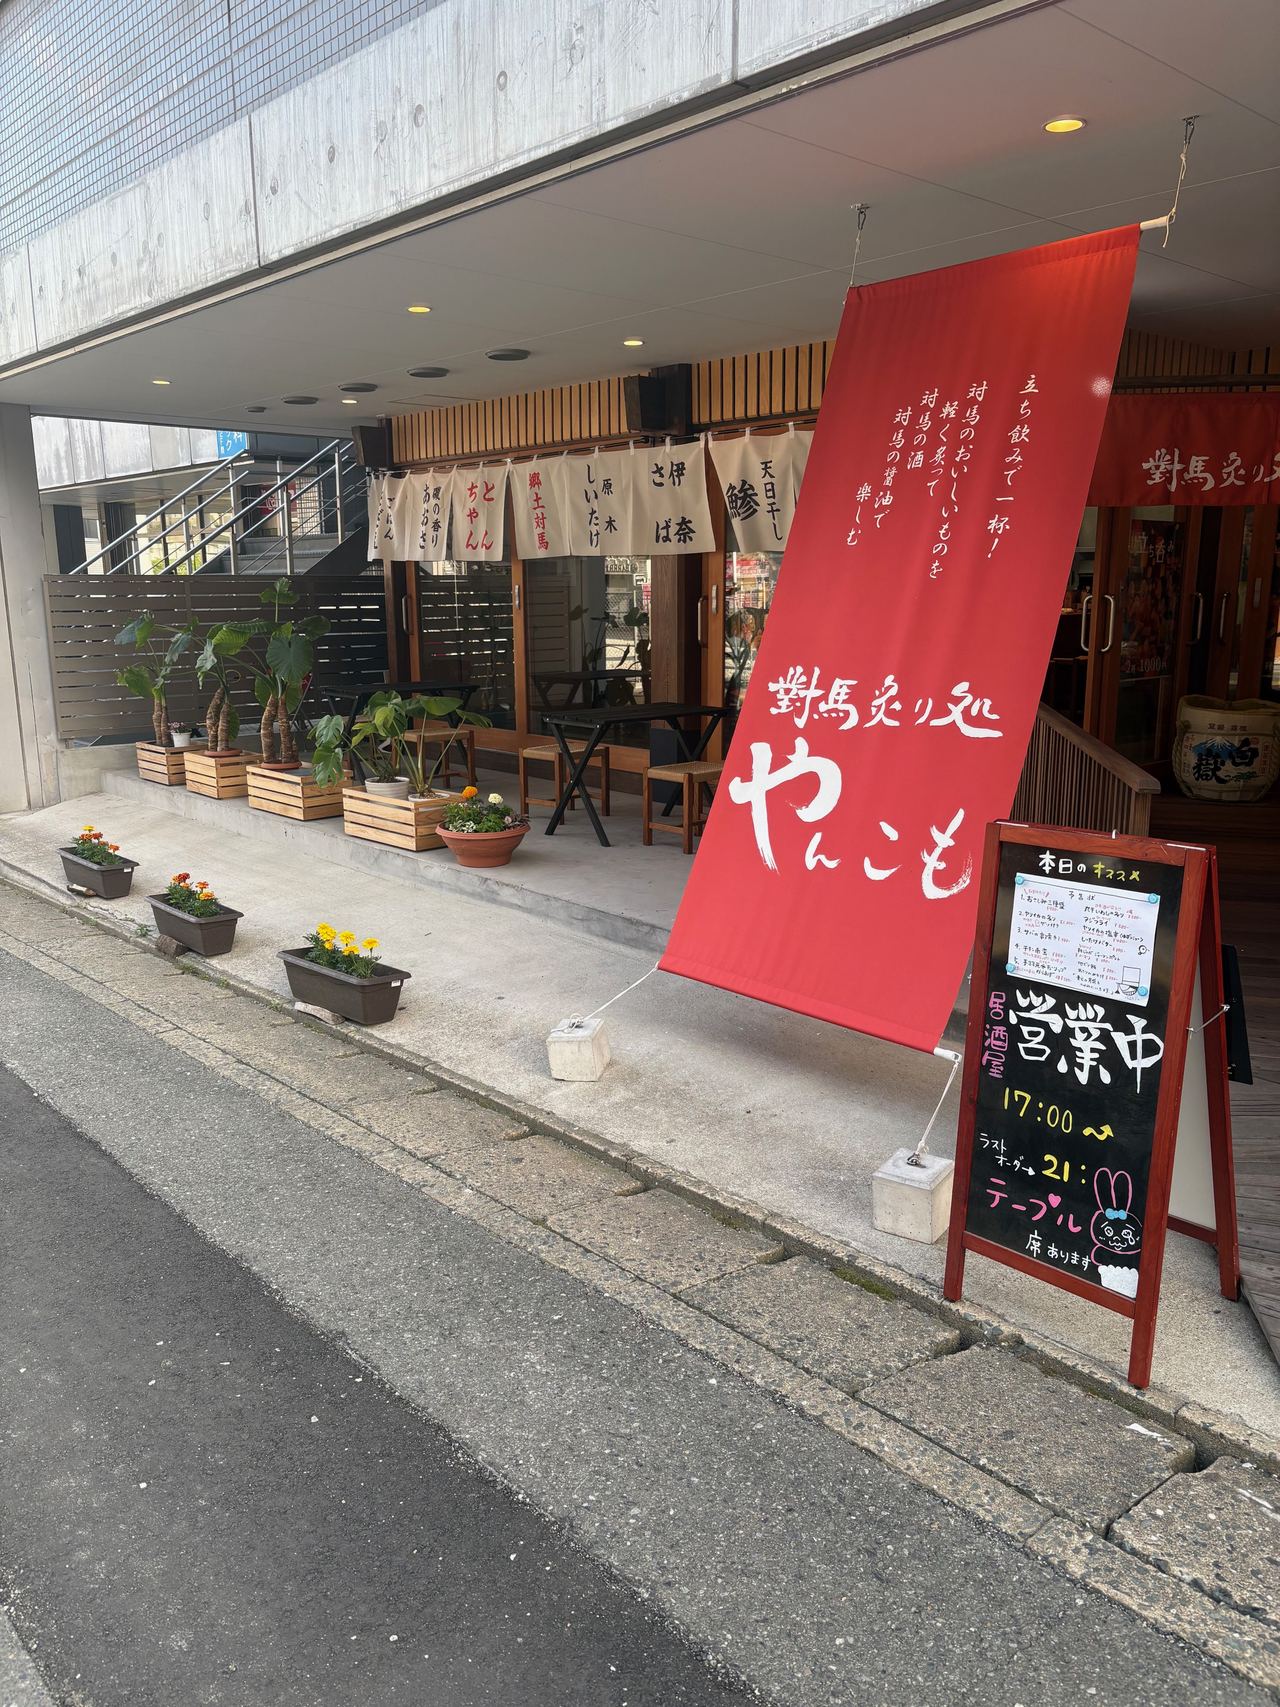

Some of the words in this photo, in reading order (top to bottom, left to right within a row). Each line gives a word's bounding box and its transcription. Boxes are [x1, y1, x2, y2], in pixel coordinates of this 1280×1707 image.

[873, 406, 913, 529] 対馬の醤油で
[907, 388, 939, 470] 対馬の酒
[926, 400, 959, 497] 軽く炙って
[987, 374, 1040, 559] 立ち飲みで一杯！
[527, 471, 551, 552] 郷土対馬
[583, 463, 602, 549] しいたけ
[600, 477, 618, 534] 原木
[758, 459, 784, 543] 天日干し
[846, 482, 873, 546] 楽しむ
[929, 380, 989, 579] 対馬のおいしいものを
[767, 664, 1004, 739] 對馬炙り処
[728, 736, 973, 900] やんこも
[1037, 850, 1087, 874] 本日の
[1092, 861, 1141, 882] オススメ
[981, 991, 1009, 1079] 居酒屋
[1008, 988, 1165, 1095] 営業中
[979, 1133, 1008, 1154] ラスト
[985, 1177, 1083, 1233] テーブル
